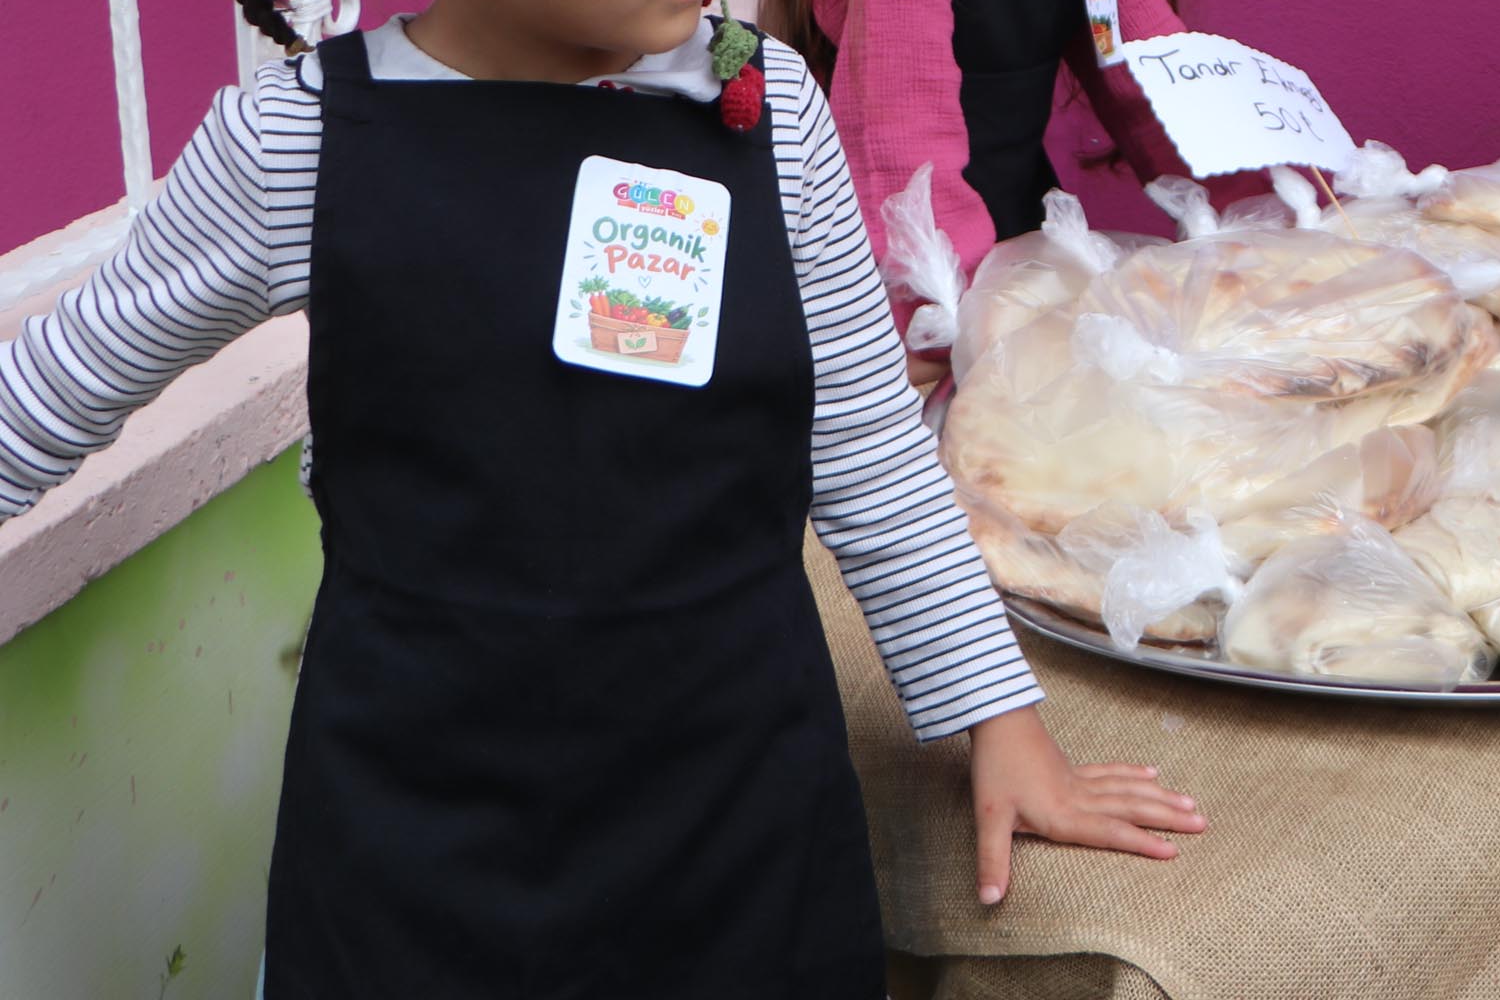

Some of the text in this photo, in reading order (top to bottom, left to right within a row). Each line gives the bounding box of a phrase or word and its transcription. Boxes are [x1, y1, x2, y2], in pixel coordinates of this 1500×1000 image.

[615, 184, 692, 213] GÜLEN
[592, 216, 707, 263] Organik
[604, 245, 696, 281] Pazar
